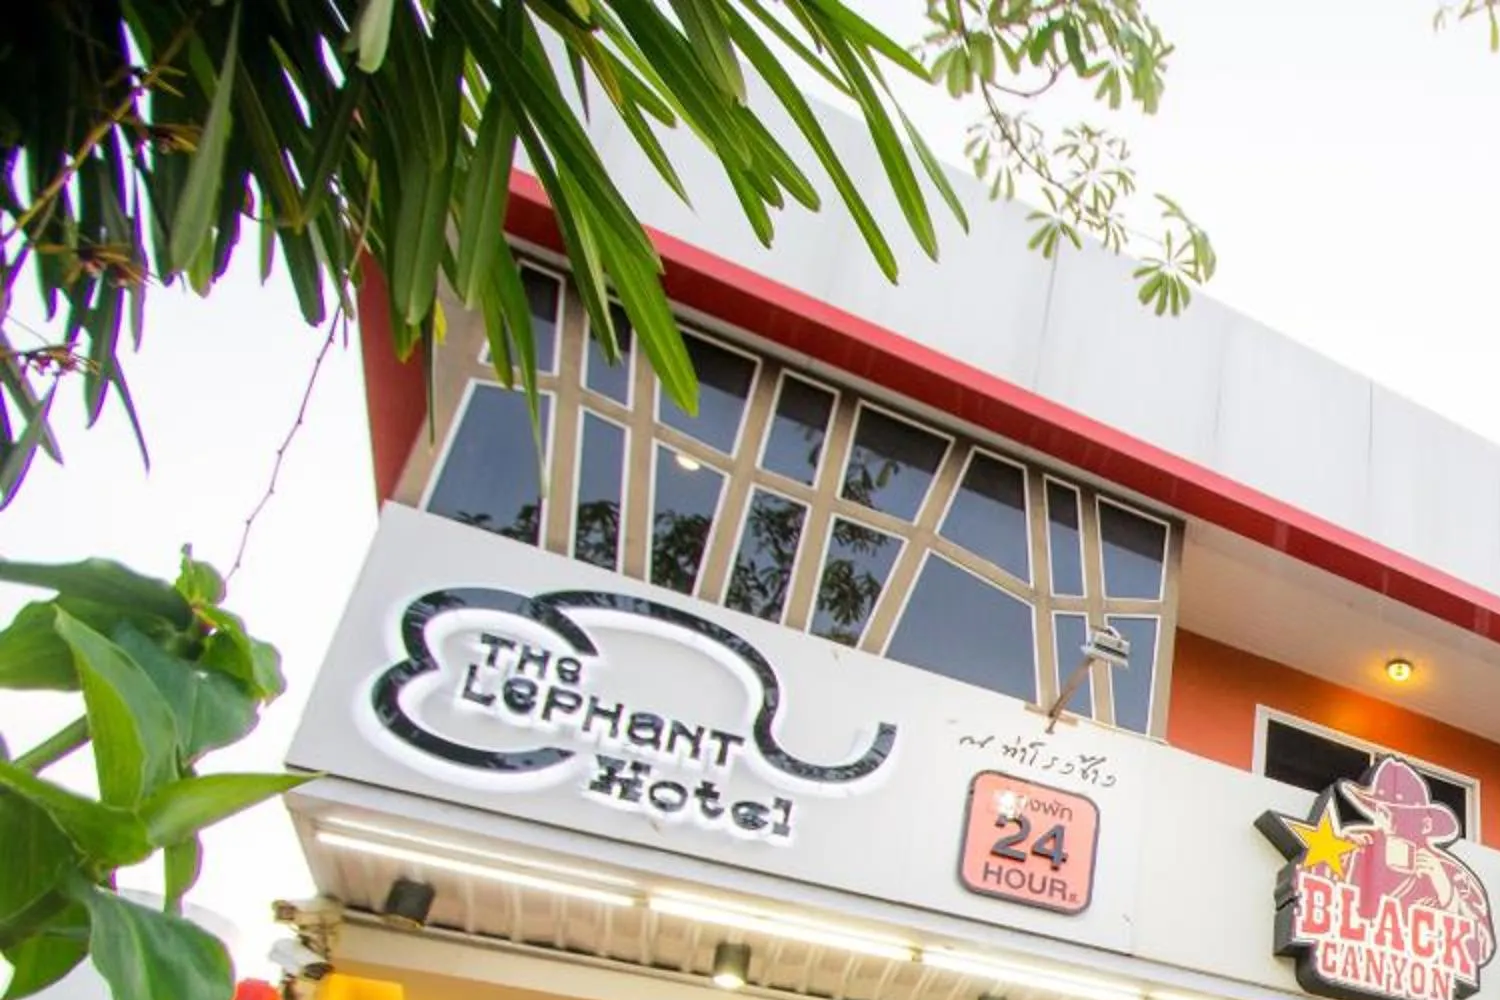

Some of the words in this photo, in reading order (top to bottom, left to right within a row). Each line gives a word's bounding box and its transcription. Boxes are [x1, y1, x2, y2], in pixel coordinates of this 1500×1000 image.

[589, 754, 793, 837] Hotel
[990, 813, 1068, 872] 24
[1300, 877, 1472, 975] BLACK
